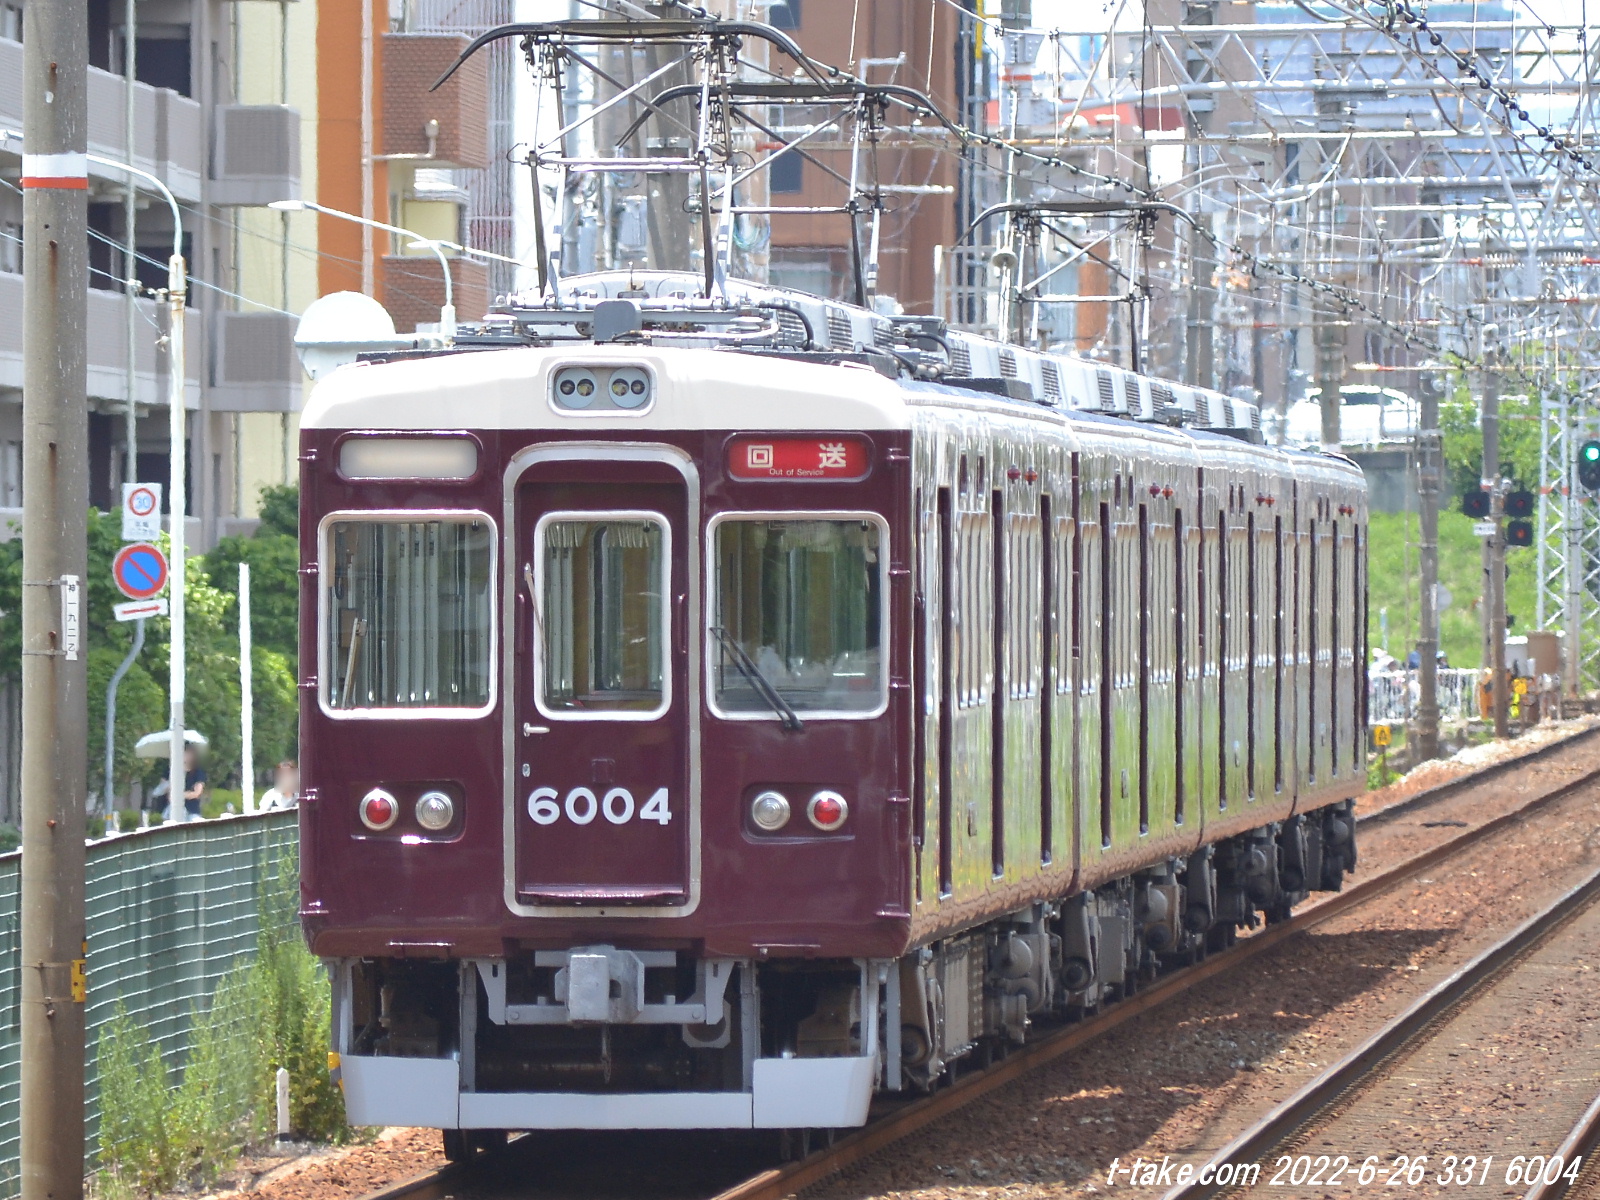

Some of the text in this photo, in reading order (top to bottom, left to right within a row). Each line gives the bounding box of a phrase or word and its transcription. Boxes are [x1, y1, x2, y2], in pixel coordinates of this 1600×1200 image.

[747, 442, 847, 469] 回送
[769, 468, 825, 476] Out of Service
[135, 495, 151, 510] 30
[527, 786, 673, 826] 6004
